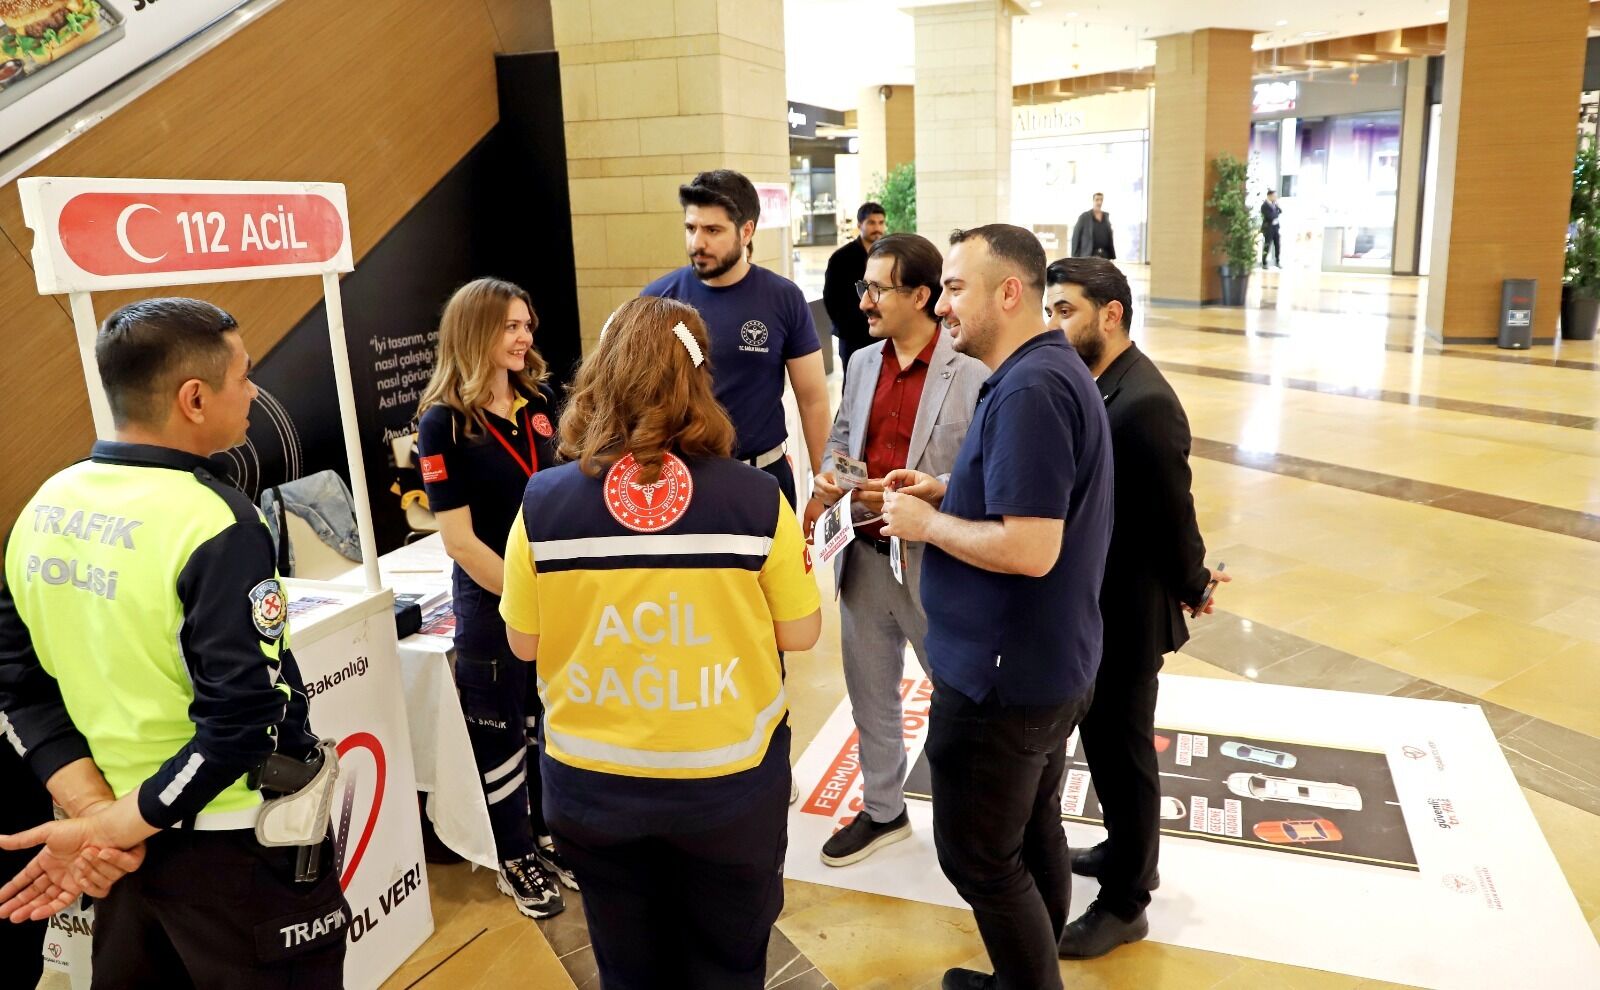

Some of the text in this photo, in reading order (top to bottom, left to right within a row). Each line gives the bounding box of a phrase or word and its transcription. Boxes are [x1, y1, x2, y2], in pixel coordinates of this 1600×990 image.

[176, 204, 308, 254] 112 ACİL
[375, 354, 398, 372] nasıl
[399, 349, 434, 369] çalıştığı
[377, 365, 436, 391] nasıl göründ
[379, 391, 397, 410] Asıl
[398, 388, 418, 404] fark
[594, 591, 713, 647] ACİL
[304, 656, 369, 699] Bakanlığı
[566, 654, 741, 712] SAĞLIK
[1063, 794, 1079, 813] SOLA
[1193, 797, 1206, 830] AMBULANS
[350, 862, 422, 943] OL VER!
